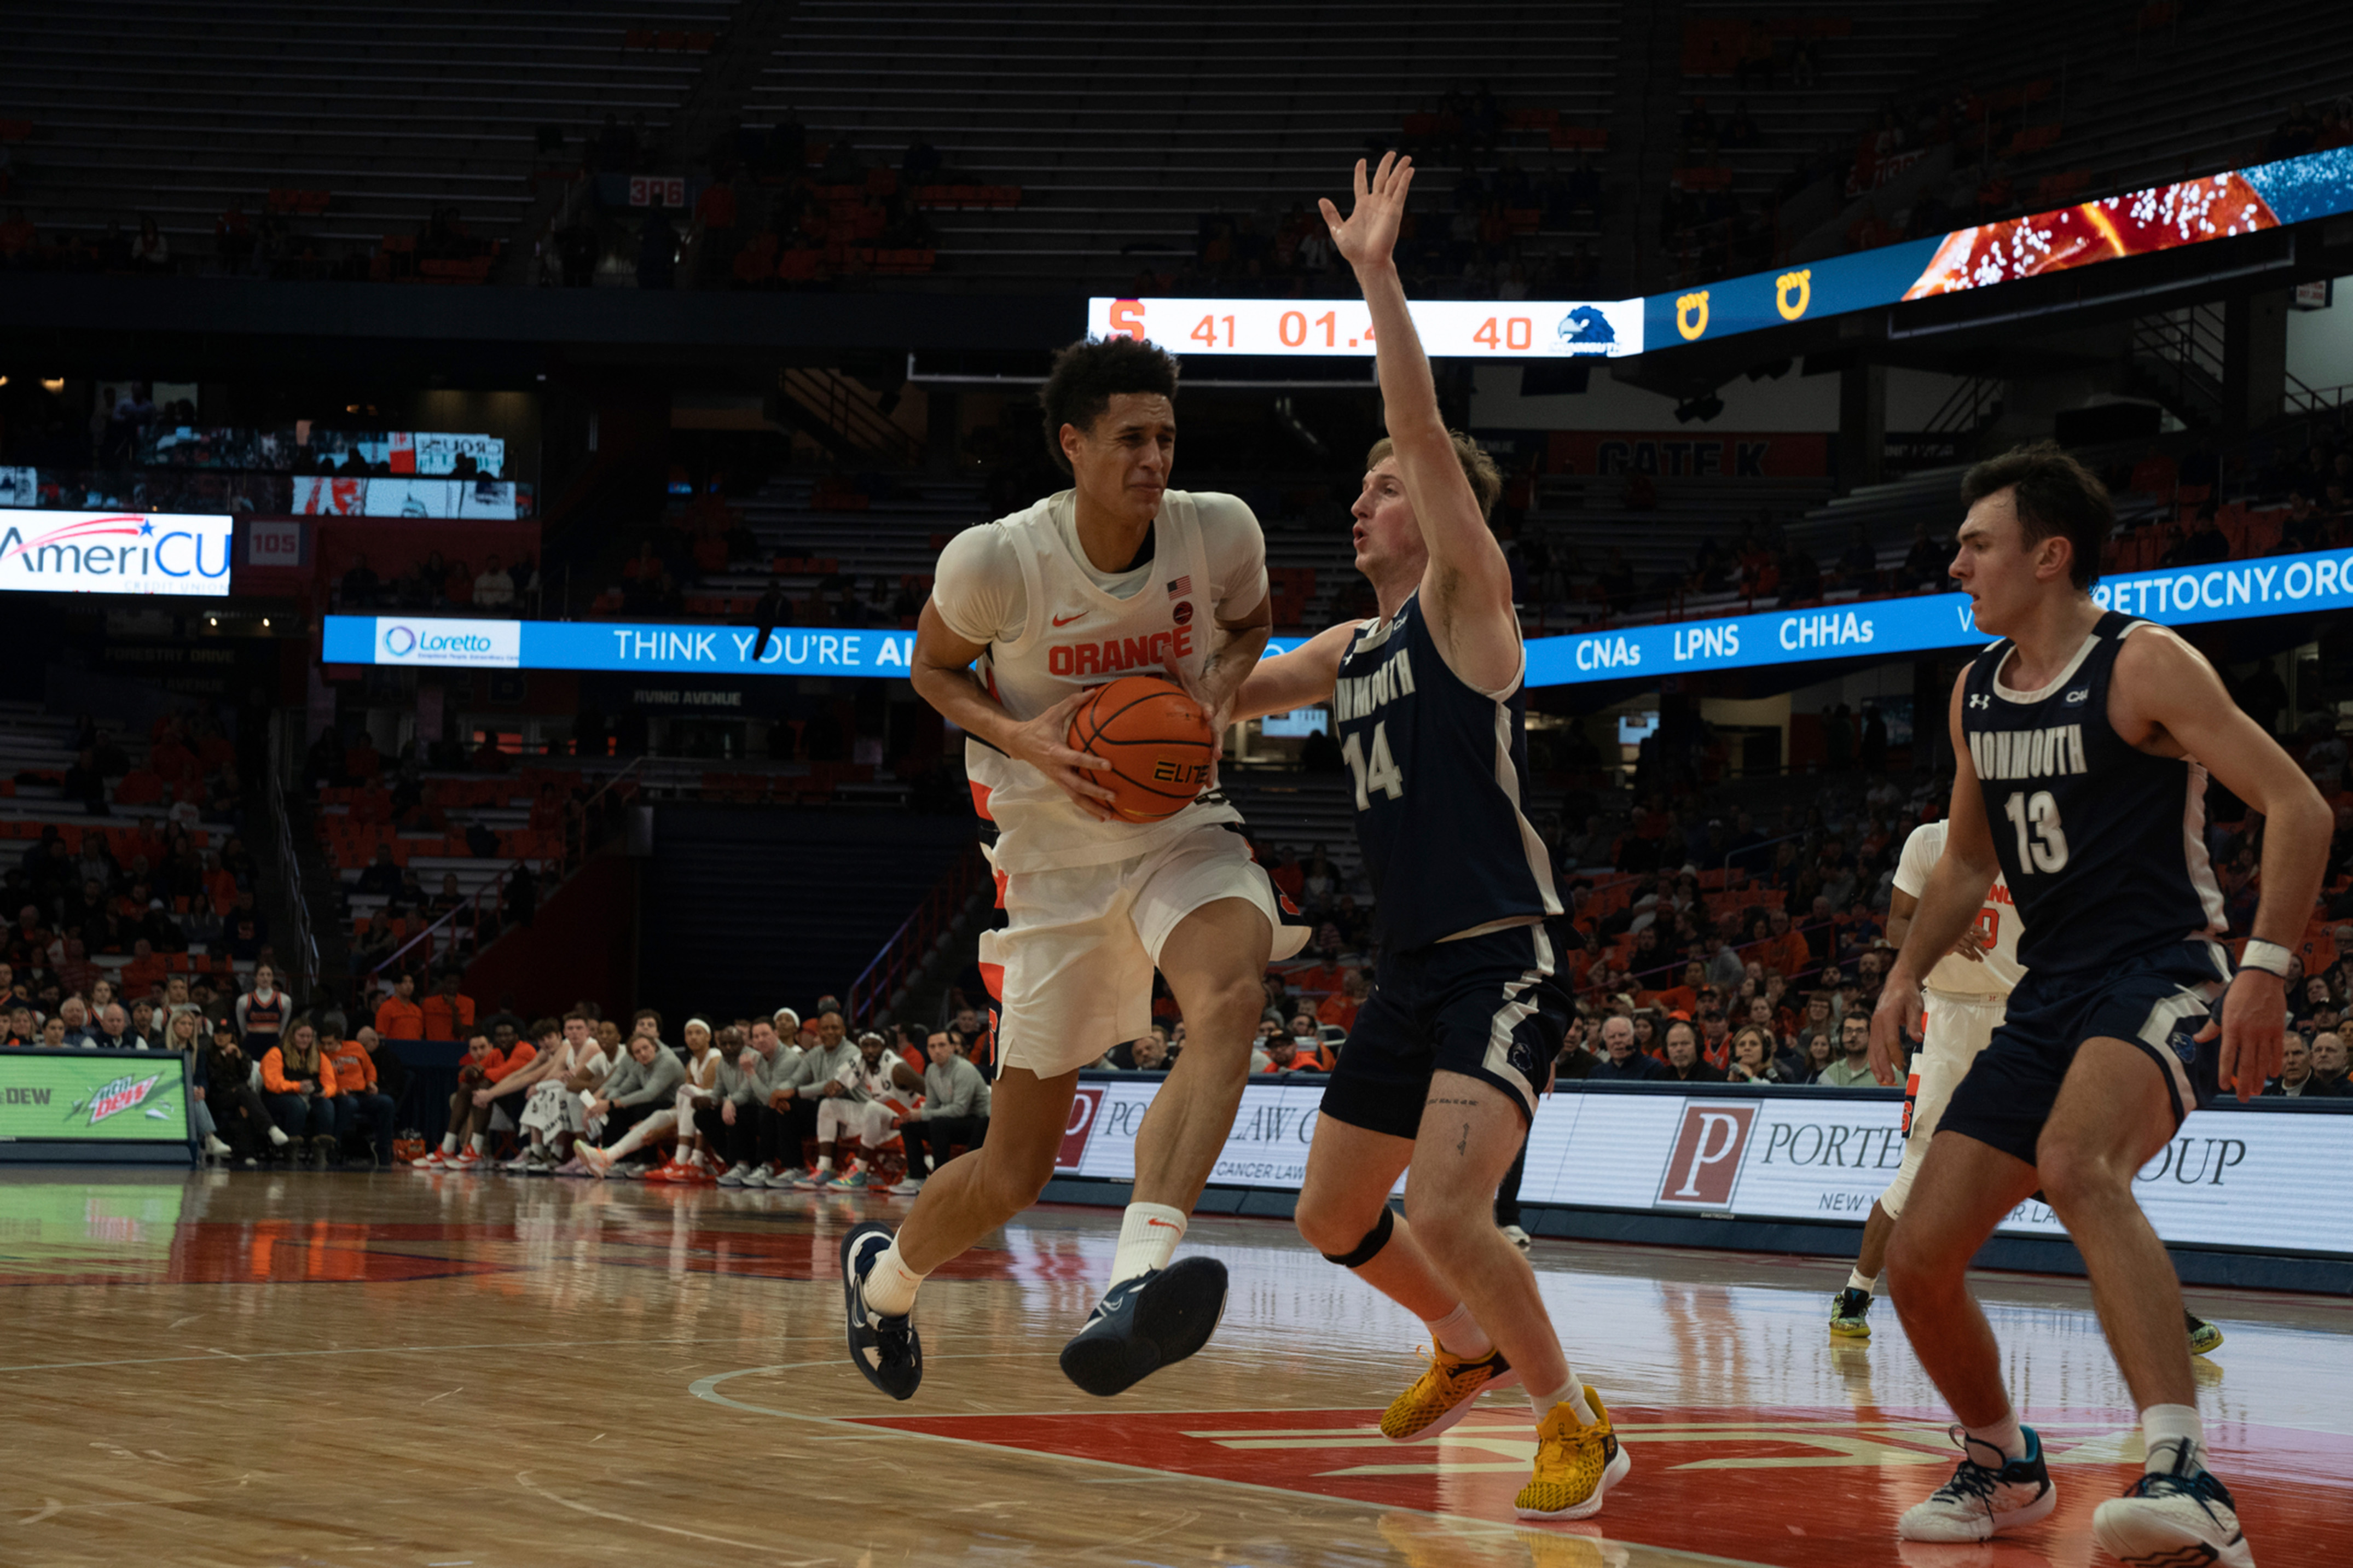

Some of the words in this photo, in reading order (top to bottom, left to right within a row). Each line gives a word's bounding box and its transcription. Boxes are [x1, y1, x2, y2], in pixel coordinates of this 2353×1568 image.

[1190, 314, 1235, 347] 41
[1278, 310, 1376, 347] 01.
[1472, 317, 1532, 350] 40
[1596, 439, 1724, 476] GATE
[1735, 439, 1770, 476] K
[0, 526, 233, 578] AmeriCU
[253, 533, 295, 554] 105
[124, 580, 174, 593] CREDIT
[180, 582, 228, 594] UNION
[420, 630, 491, 652] Loretto
[613, 629, 717, 662] THINK
[732, 633, 861, 666] YOU'RE
[1674, 624, 1740, 661] LPNS
[1779, 611, 1874, 651] CHHAs
[190, 648, 236, 664] DRIVE
[1048, 625, 1193, 676] ORANGE
[1576, 636, 1641, 671] CNAs
[682, 690, 741, 707] AVENUE
[1154, 760, 1210, 784] ELITE
[1342, 720, 1404, 812] 14
[2003, 790, 2070, 874] 13
[5, 1088, 51, 1105] DEW
[1217, 1162, 1272, 1179] CANCER
[1674, 1112, 1739, 1197] P
[1760, 1123, 1904, 1169] PORTE
[2135, 1137, 2247, 1186] OUP
[1818, 1193, 1865, 1212] NEW
